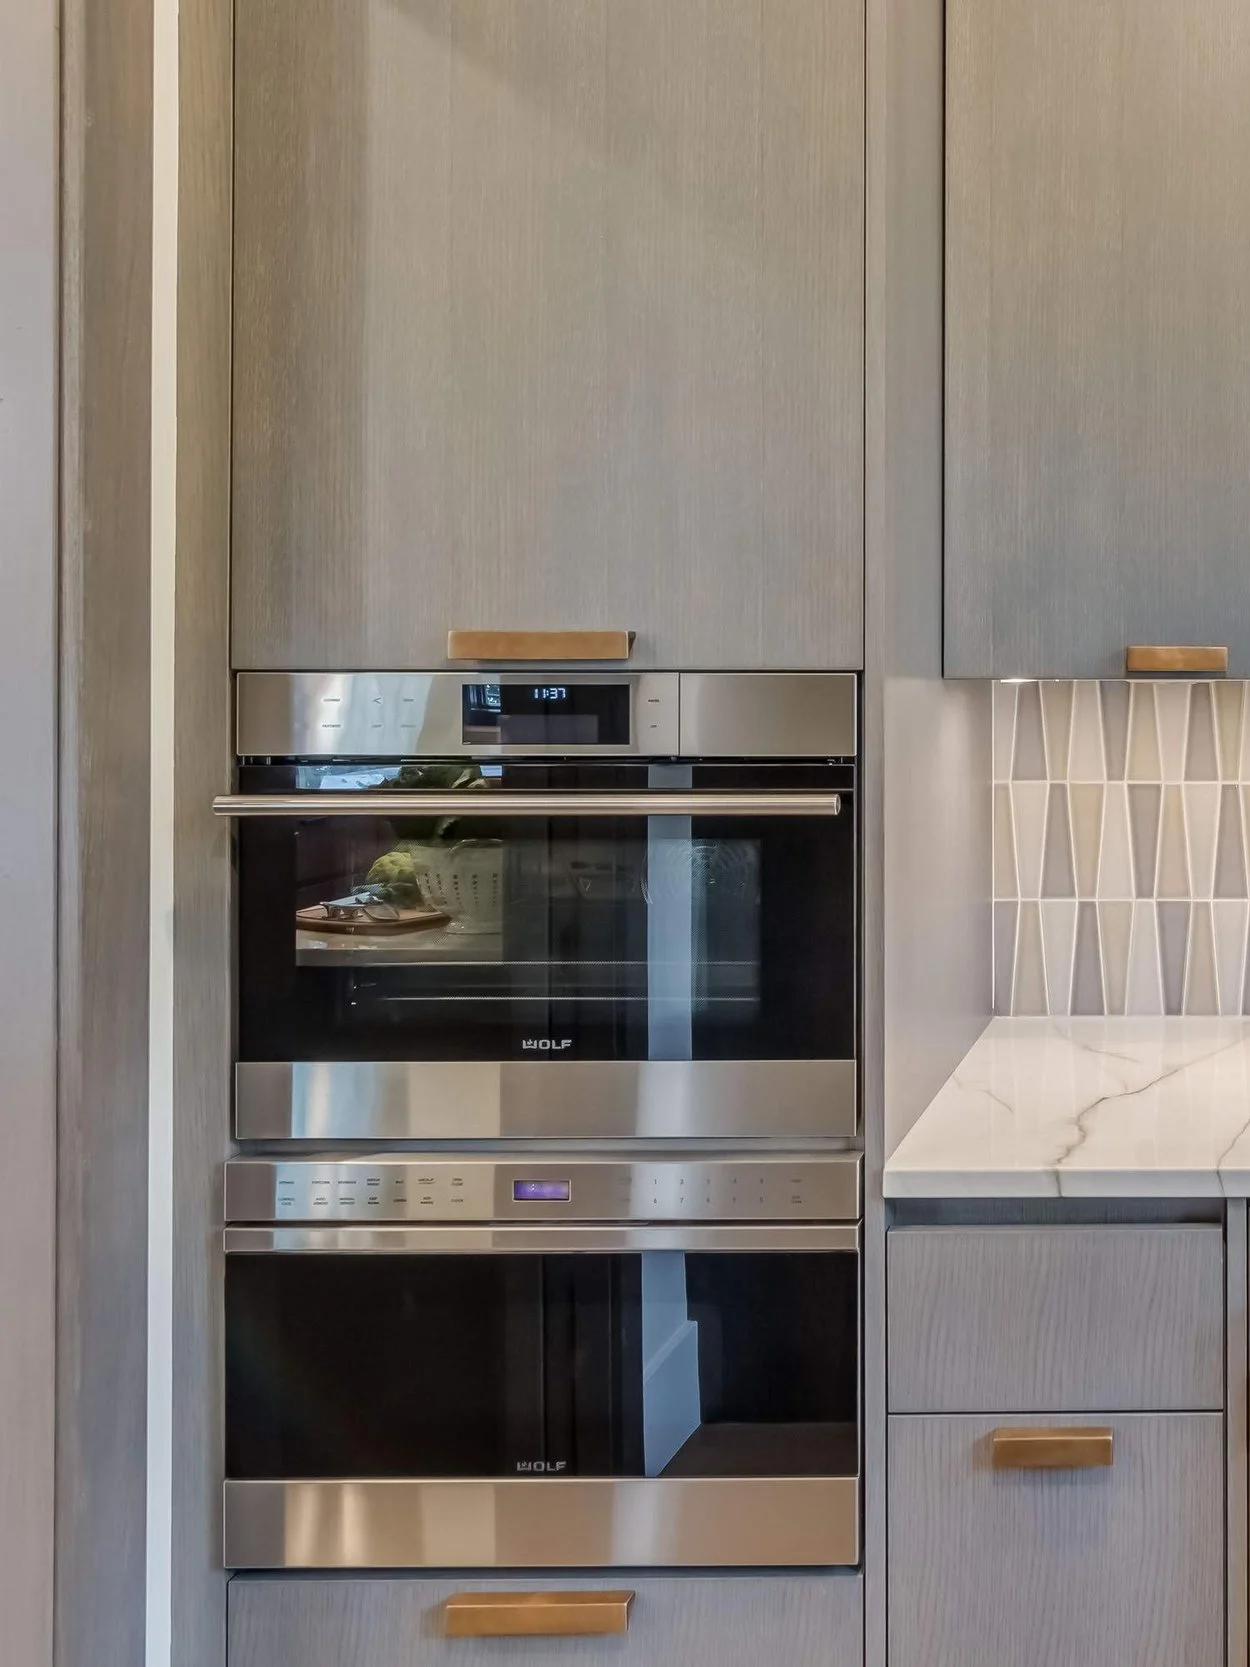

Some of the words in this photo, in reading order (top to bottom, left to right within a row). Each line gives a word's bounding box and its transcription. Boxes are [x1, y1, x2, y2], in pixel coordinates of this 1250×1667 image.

[534, 687, 566, 699] 11:37
[522, 1039, 572, 1050] WOLF
[516, 1461, 566, 1472] WOLF
